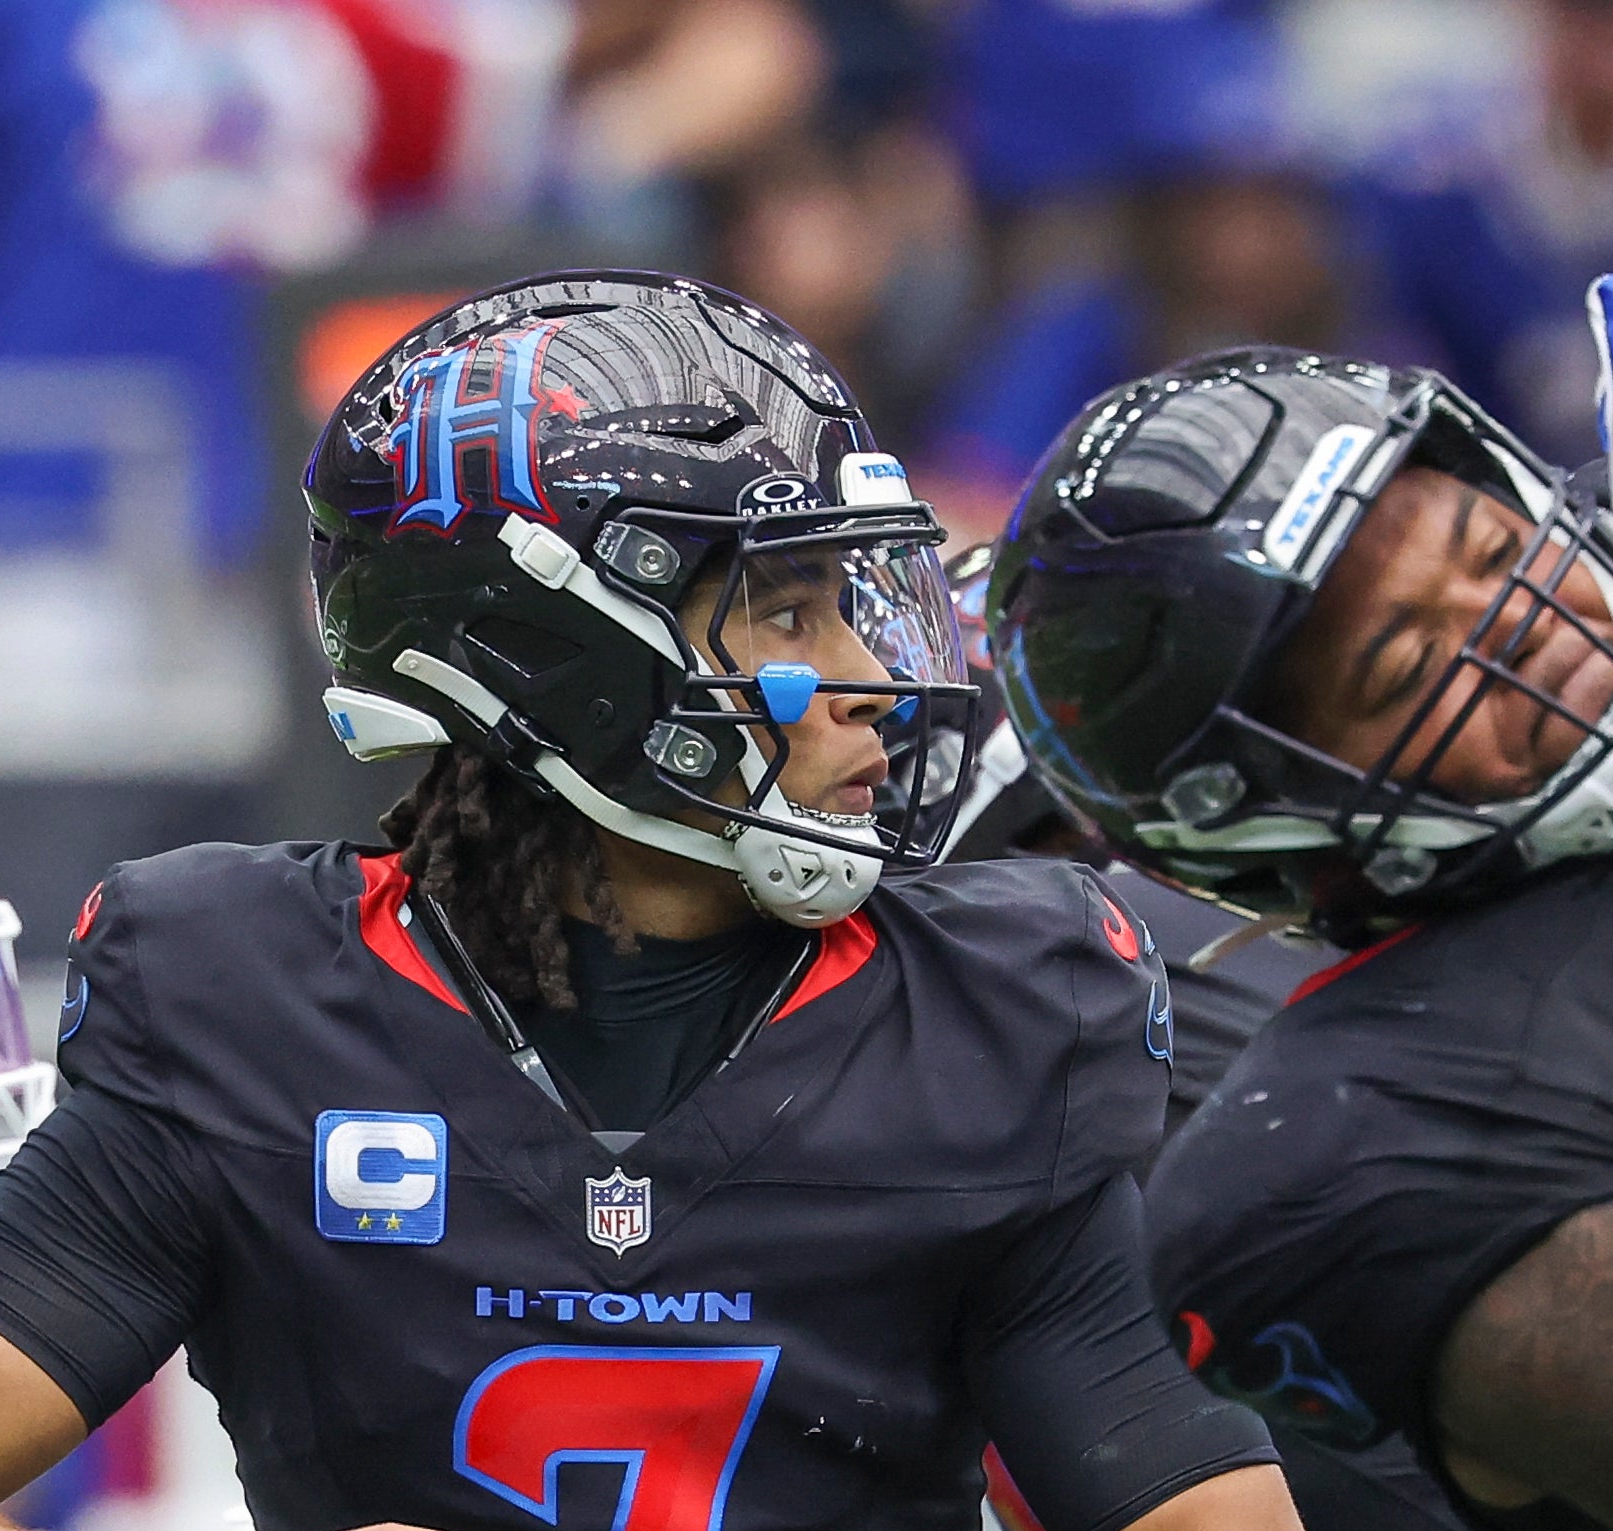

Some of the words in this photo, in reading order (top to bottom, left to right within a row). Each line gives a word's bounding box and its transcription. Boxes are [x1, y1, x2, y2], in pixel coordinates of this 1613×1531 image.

[388, 320, 563, 538] H
[741, 498, 822, 517] OAKLEY
[326, 1120, 437, 1211] C
[597, 1208, 642, 1240] NFL
[475, 1286, 753, 1324] H-TOWN
